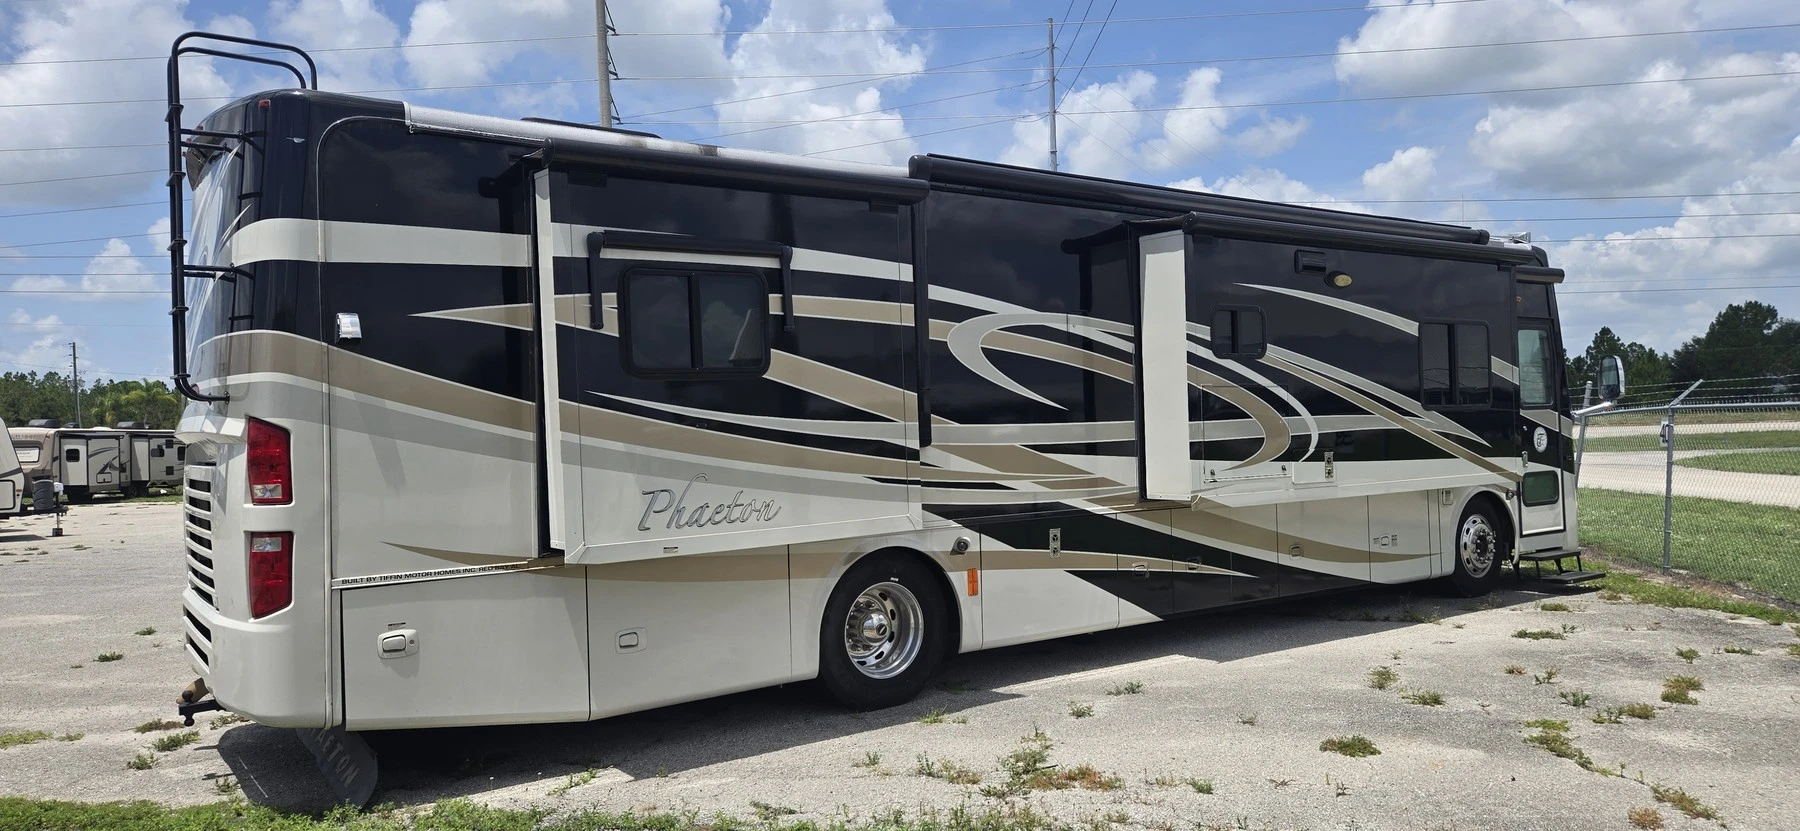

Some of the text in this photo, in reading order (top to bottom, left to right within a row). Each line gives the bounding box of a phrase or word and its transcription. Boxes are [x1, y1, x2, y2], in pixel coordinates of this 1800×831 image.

[638, 473, 781, 531] Phaeton
[341, 577, 365, 585] BUILT
[404, 571, 432, 579] MOTOR
[433, 569, 461, 577] HOMES
